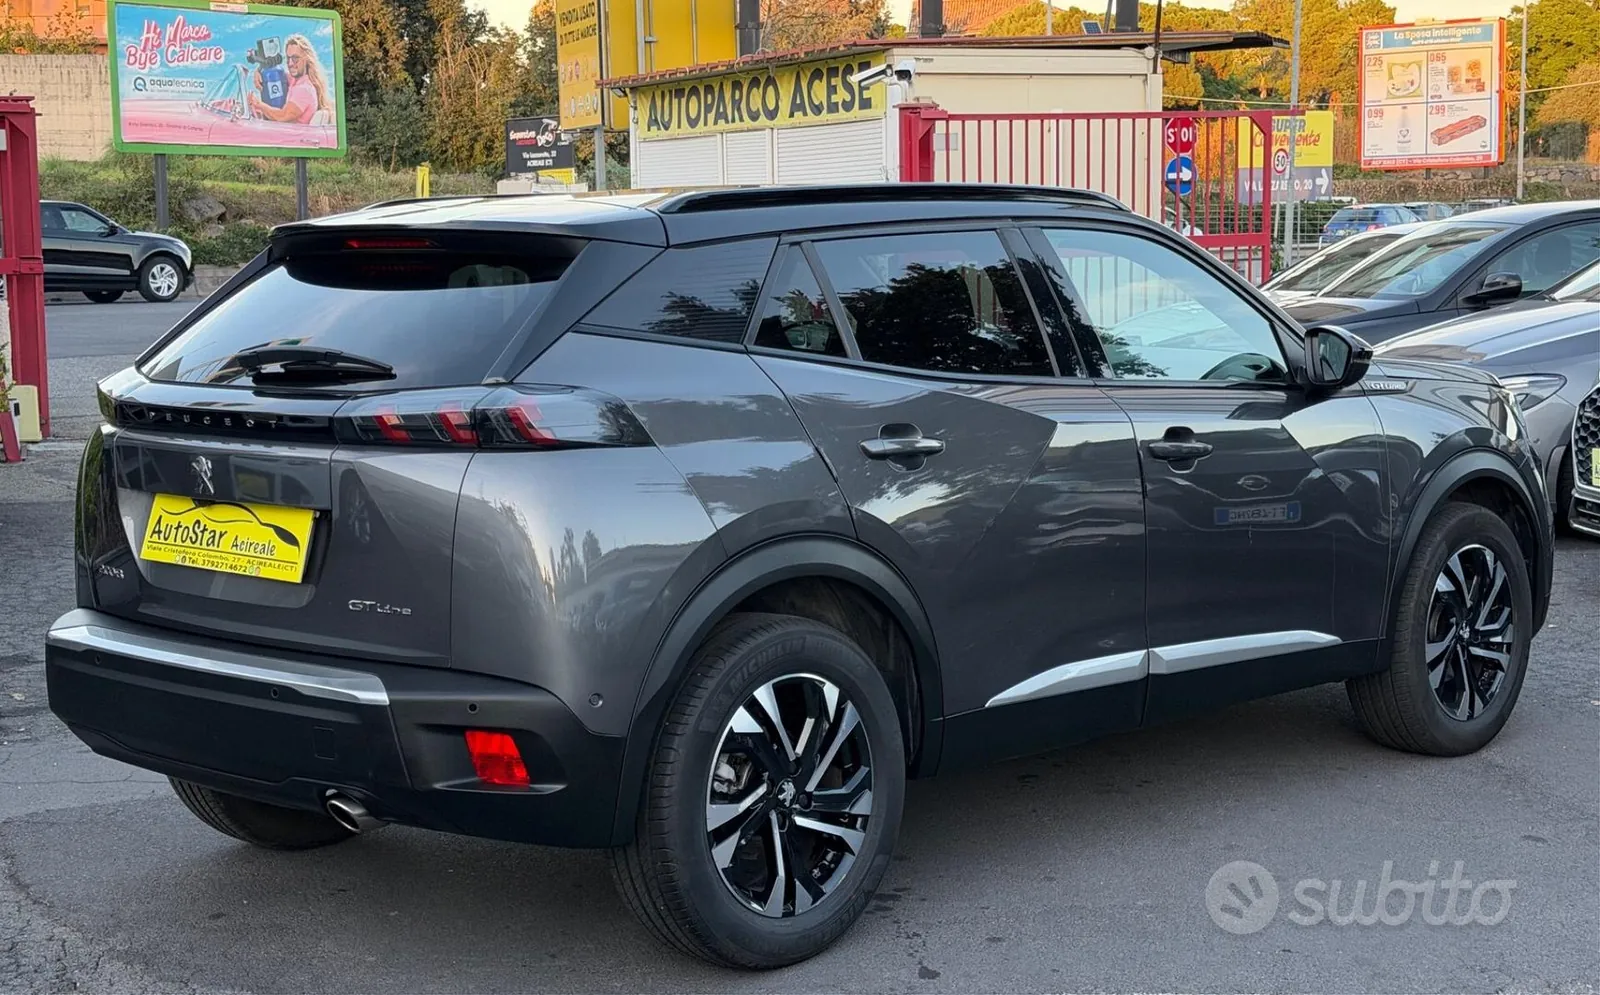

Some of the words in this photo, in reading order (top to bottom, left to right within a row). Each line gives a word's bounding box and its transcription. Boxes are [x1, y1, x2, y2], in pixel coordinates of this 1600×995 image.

[140, 19, 160, 51] Hi
[165, 15, 210, 48] Marco
[126, 45, 158, 70] Bye
[166, 42, 222, 65] Calcare
[150, 78, 205, 88] aquatecnica
[648, 75, 781, 132] AUTOPARCO
[788, 61, 873, 119] ACESE
[1271, 118, 1306, 132] UPR
[1276, 155, 1286, 167] 50
[149, 411, 277, 429] PEUGEOT
[150, 515, 227, 548] AutoStar
[231, 535, 276, 557] Acireale
[146, 544, 162, 552] Viale
[163, 546, 196, 557] Cristoforo
[188, 557, 199, 565] Tel.
[201, 559, 248, 573] 3792714672
[348, 599, 376, 611] GT
[729, 636, 807, 692] MICHELIN
